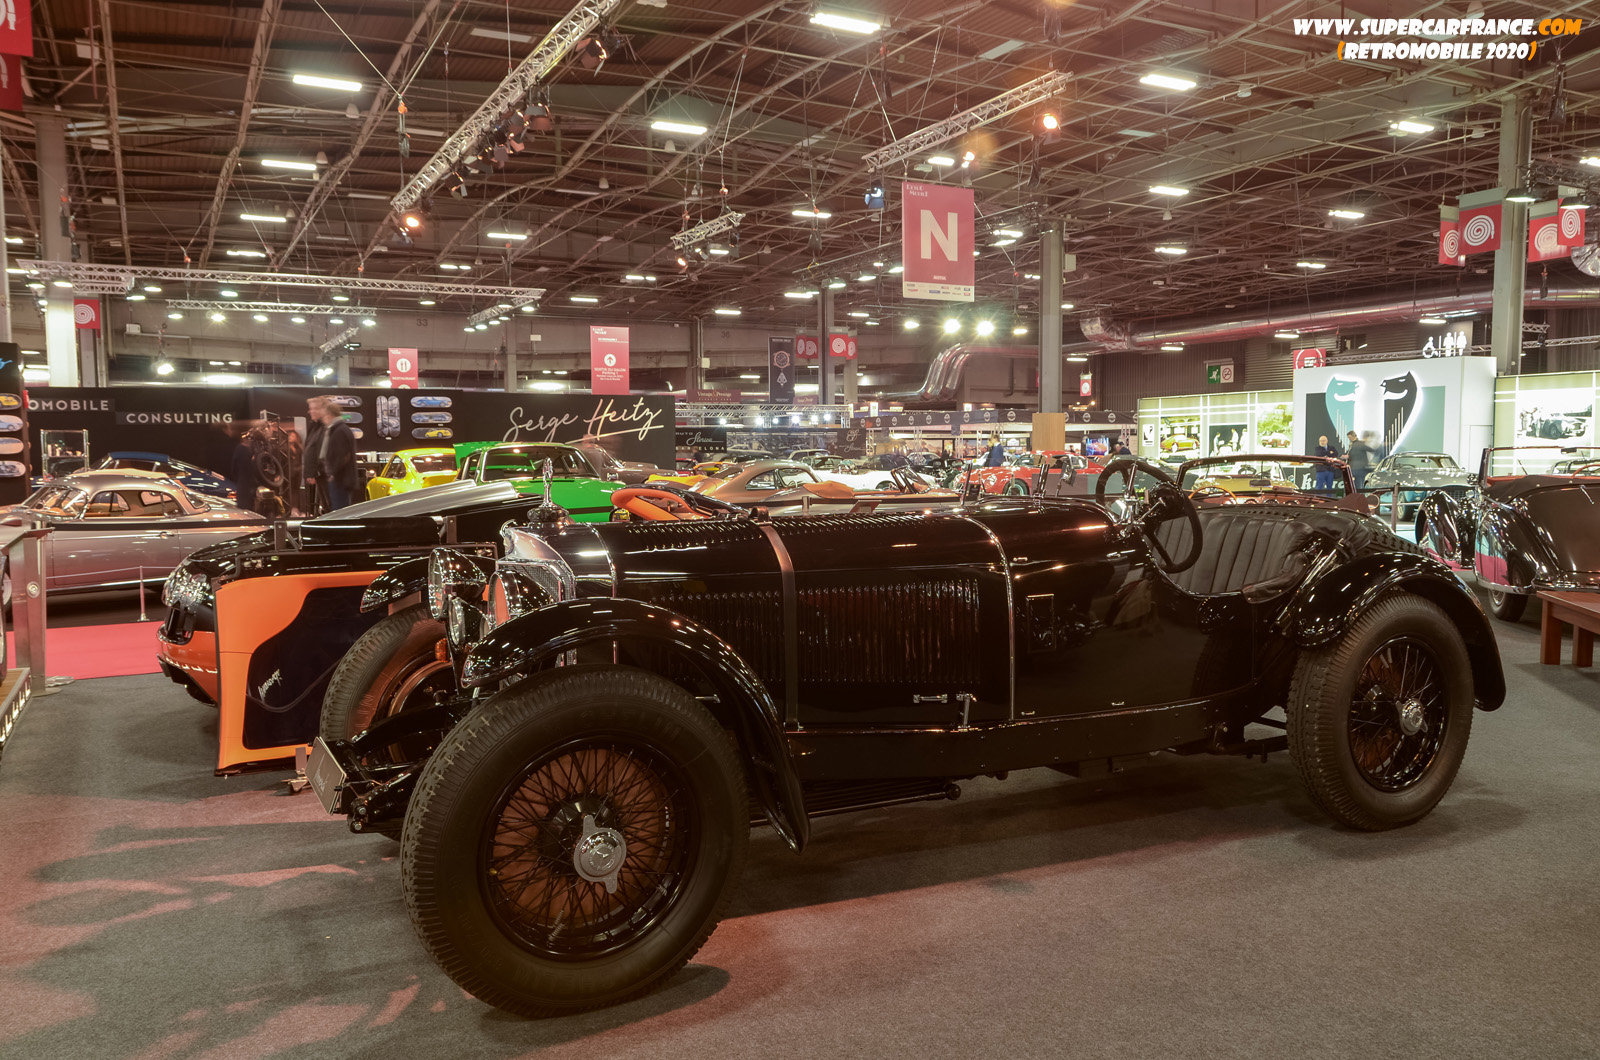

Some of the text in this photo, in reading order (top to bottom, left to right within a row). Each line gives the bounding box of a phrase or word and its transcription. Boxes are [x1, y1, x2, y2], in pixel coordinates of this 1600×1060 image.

[920, 208, 959, 262] N
[416, 318, 429, 327] 33
[126, 413, 233, 424] CONSULTING
[503, 396, 662, 442] Serge Heitz
